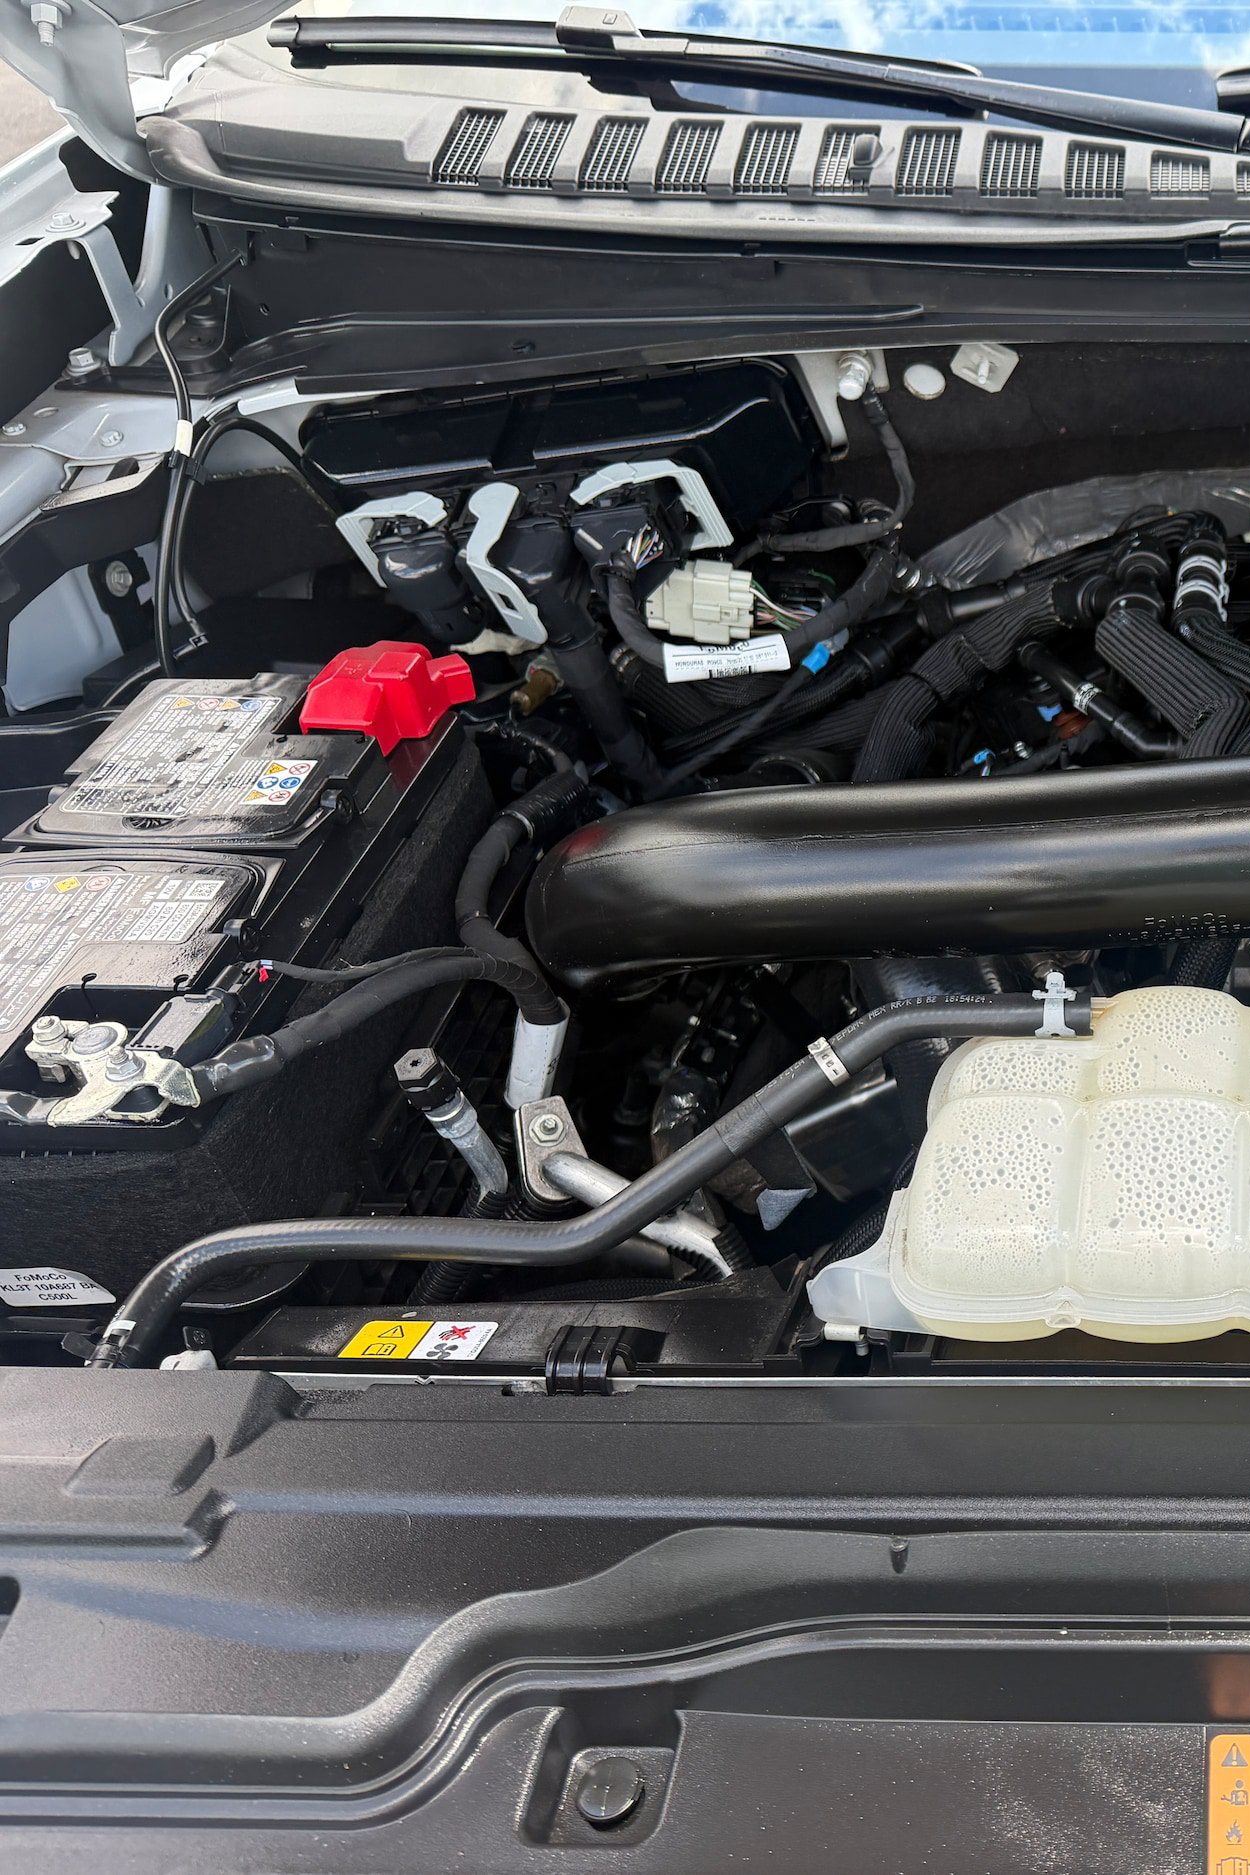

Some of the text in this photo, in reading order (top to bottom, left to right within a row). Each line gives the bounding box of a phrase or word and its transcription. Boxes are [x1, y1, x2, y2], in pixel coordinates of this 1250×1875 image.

[868, 1005, 887, 1020] MEX
[14, 1273, 68, 1282] FoMoCo
[0, 1284, 31, 1292] KL3T
[38, 1293, 78, 1301] C500L
